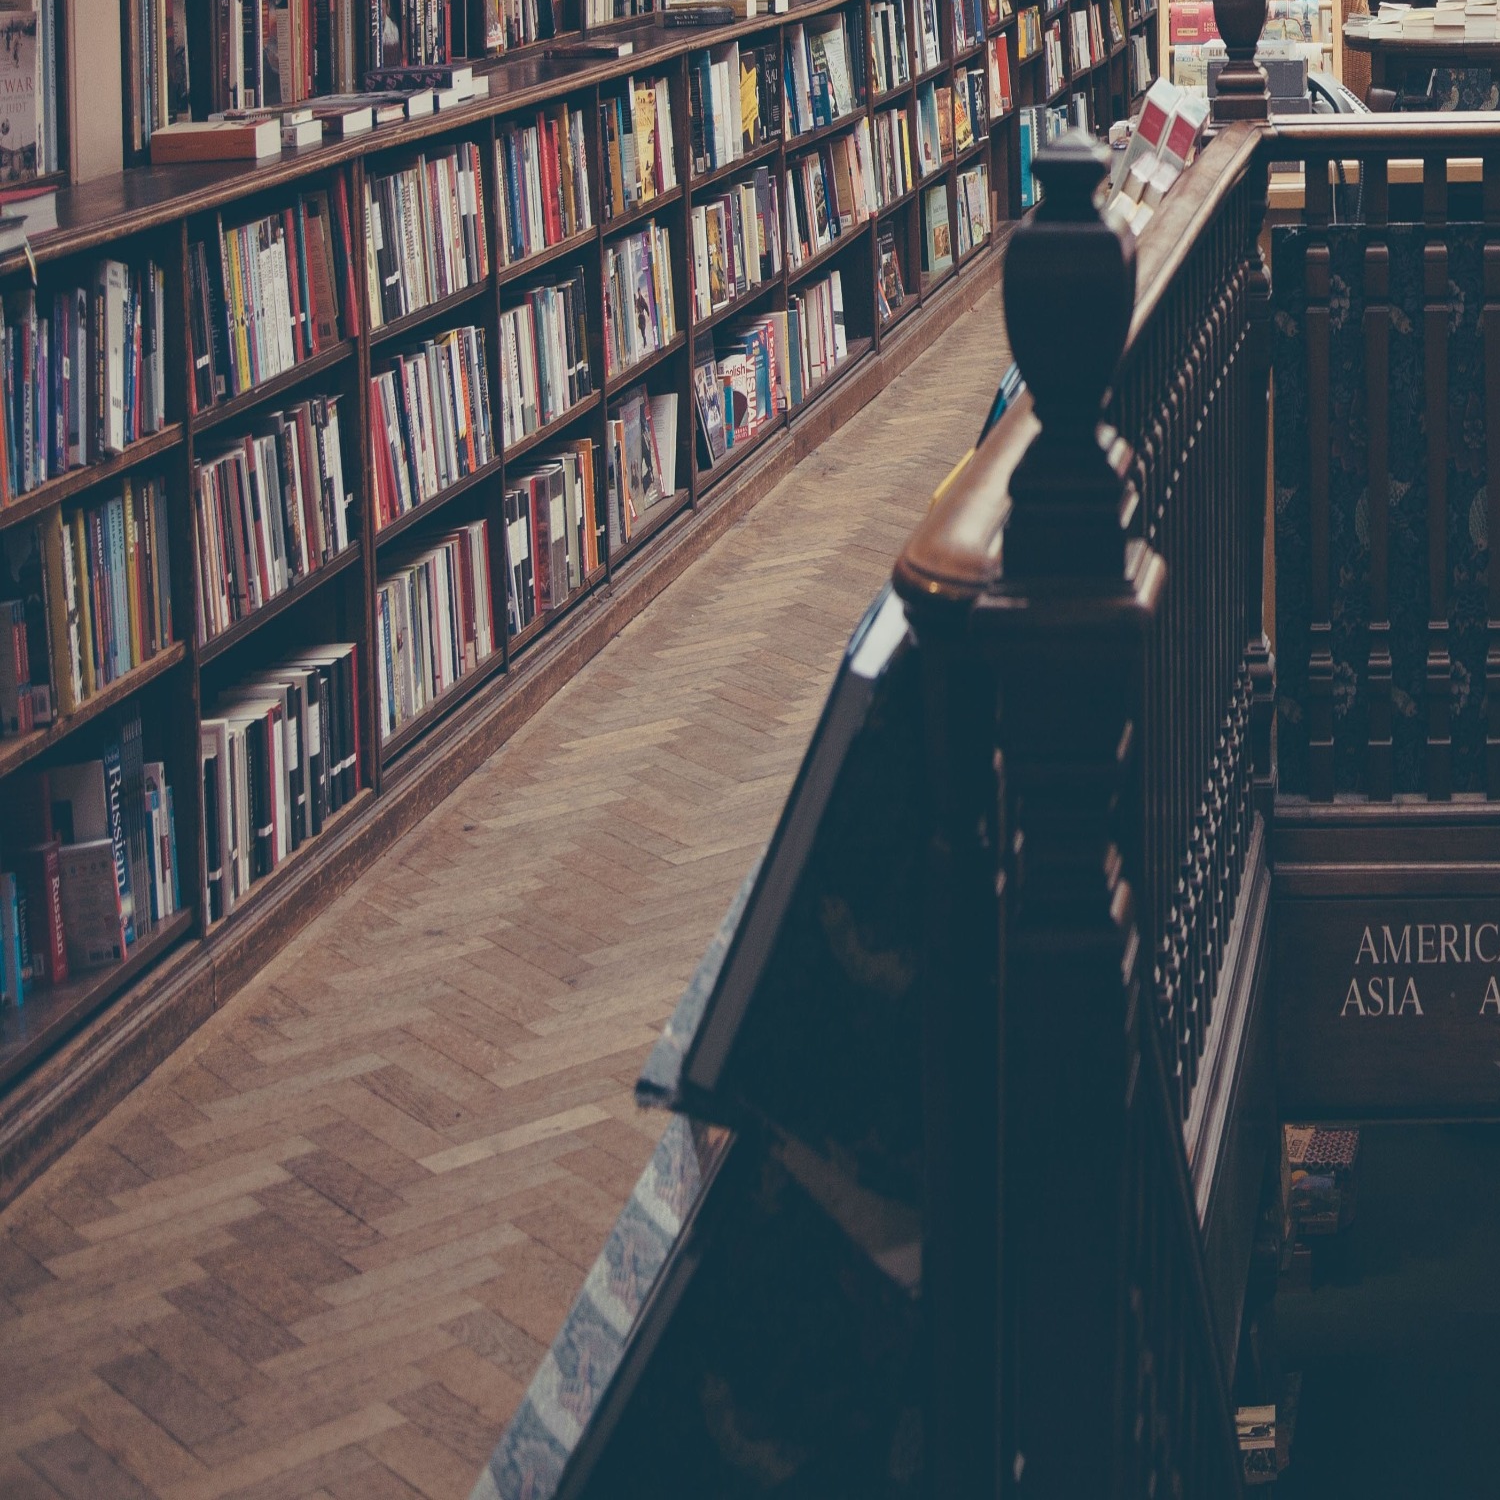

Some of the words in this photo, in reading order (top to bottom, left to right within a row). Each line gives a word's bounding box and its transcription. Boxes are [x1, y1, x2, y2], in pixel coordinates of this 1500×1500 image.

[766, 336, 778, 387] Polish
[23, 382, 31, 424] BALTIC
[746, 354, 757, 436] VISUAL
[23, 427, 31, 472] STATES
[95, 517, 104, 565] KURKOV
[109, 508, 117, 555] KURKOV
[115, 503, 123, 551] KURKOV
[108, 764, 126, 888] Russian
[19, 898, 30, 968] Russian
[52, 876, 63, 955] Russian
[1340, 976, 1425, 1017] ASIA
